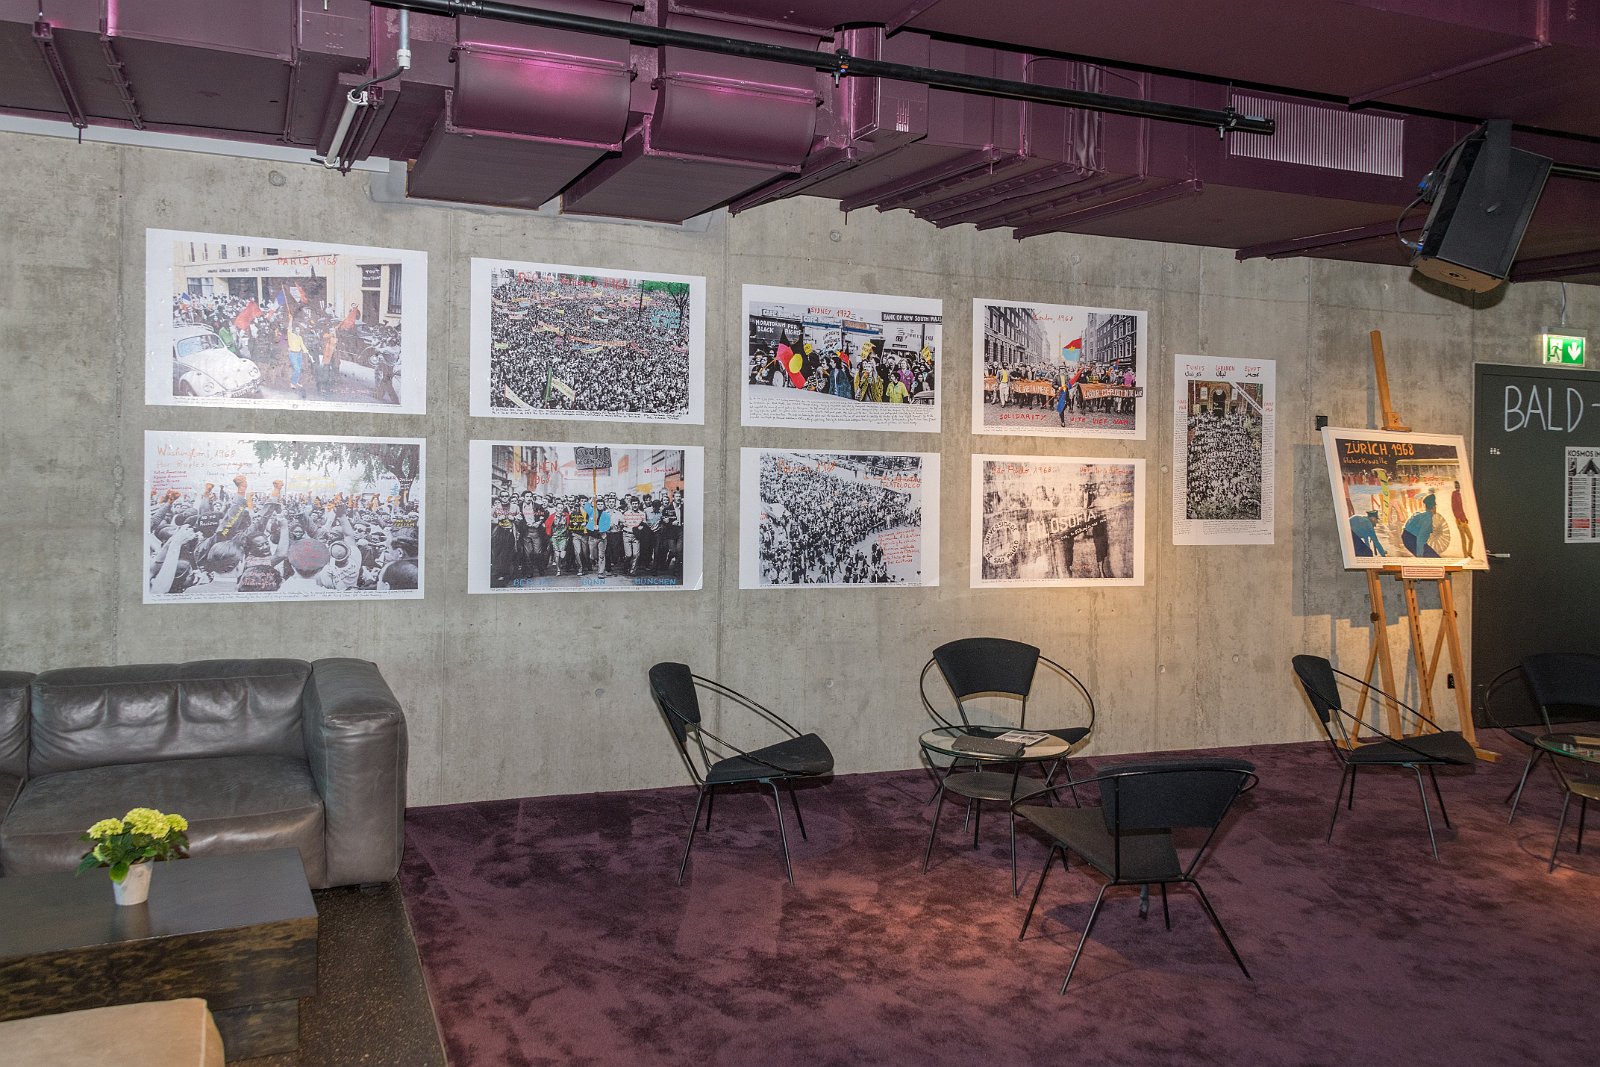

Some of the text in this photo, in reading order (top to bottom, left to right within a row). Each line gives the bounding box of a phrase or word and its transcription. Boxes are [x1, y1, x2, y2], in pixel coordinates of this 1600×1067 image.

[277, 257, 309, 266] PARIS
[1504, 384, 1584, 433] BALD
[1391, 444, 1415, 456] 1968
